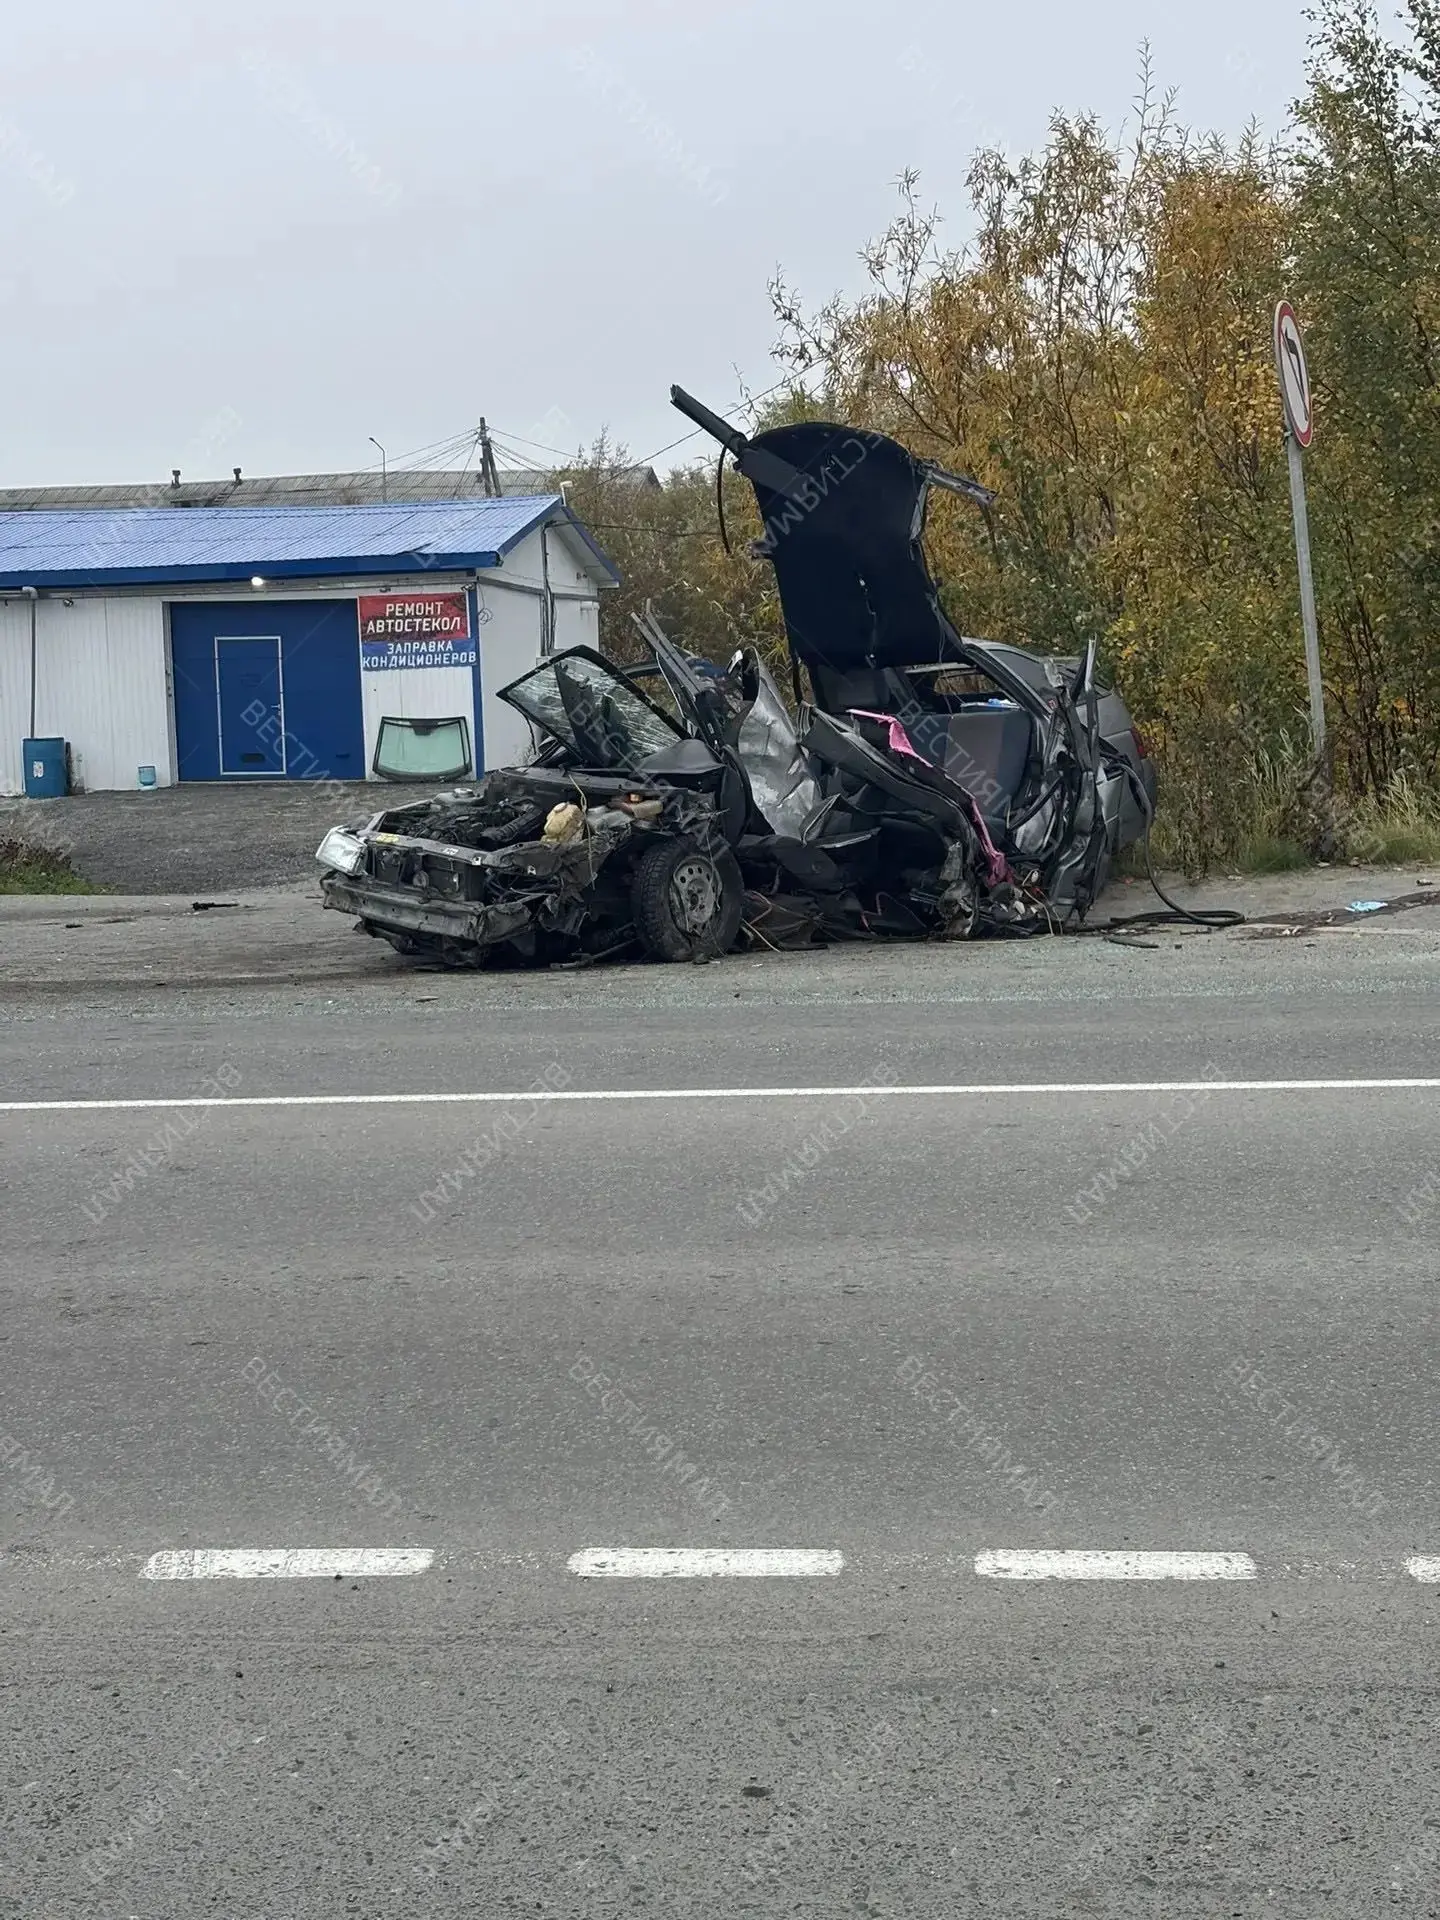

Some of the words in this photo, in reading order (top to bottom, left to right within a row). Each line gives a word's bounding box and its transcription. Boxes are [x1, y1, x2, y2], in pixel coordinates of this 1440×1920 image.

[386, 602, 444, 617] РЕМОНТ
[366, 617, 461, 633] АВТОСТЕКОЛ
[387, 641, 454, 655] ЗАПРАВКА
[362, 651, 477, 668] КОНДИЦИОНЕРОВ
